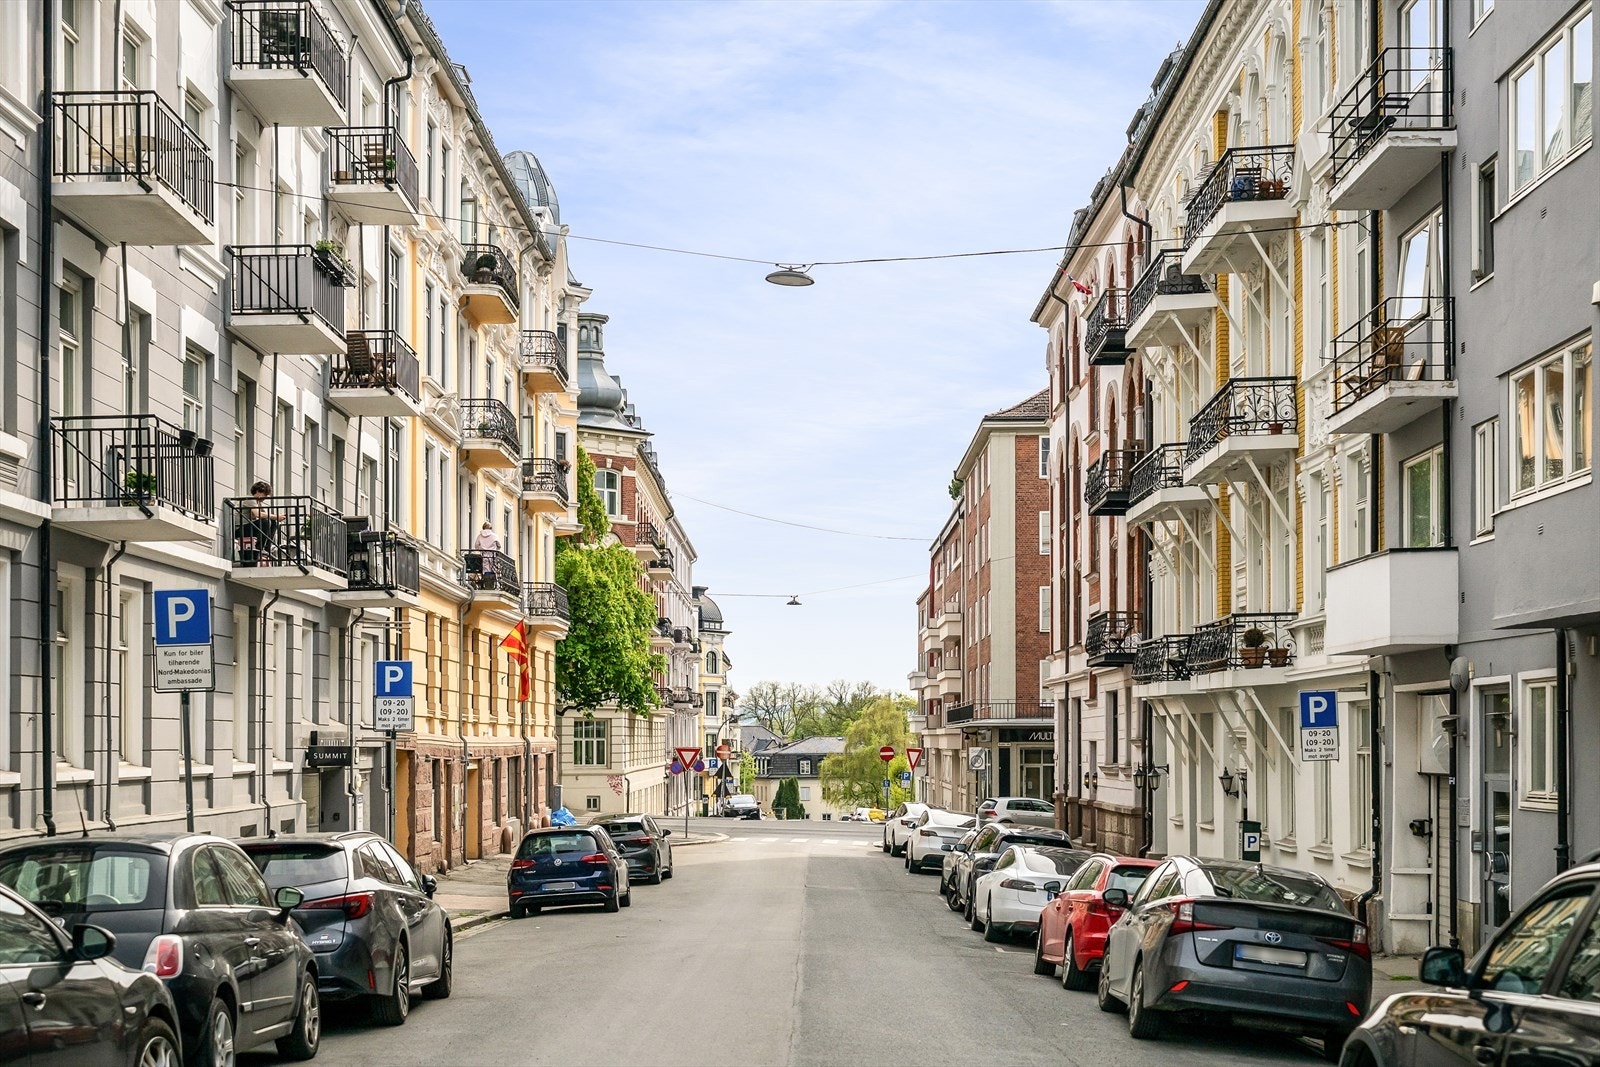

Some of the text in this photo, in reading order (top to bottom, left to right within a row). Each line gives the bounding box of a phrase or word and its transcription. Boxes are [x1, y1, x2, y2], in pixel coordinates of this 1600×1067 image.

[167, 596, 195, 638] P
[158, 668, 211, 676] Nord-Makedonias
[167, 677, 203, 685] ambassade
[385, 665, 404, 693] P
[1308, 696, 1328, 724] P
[1247, 835, 1258, 849] P
